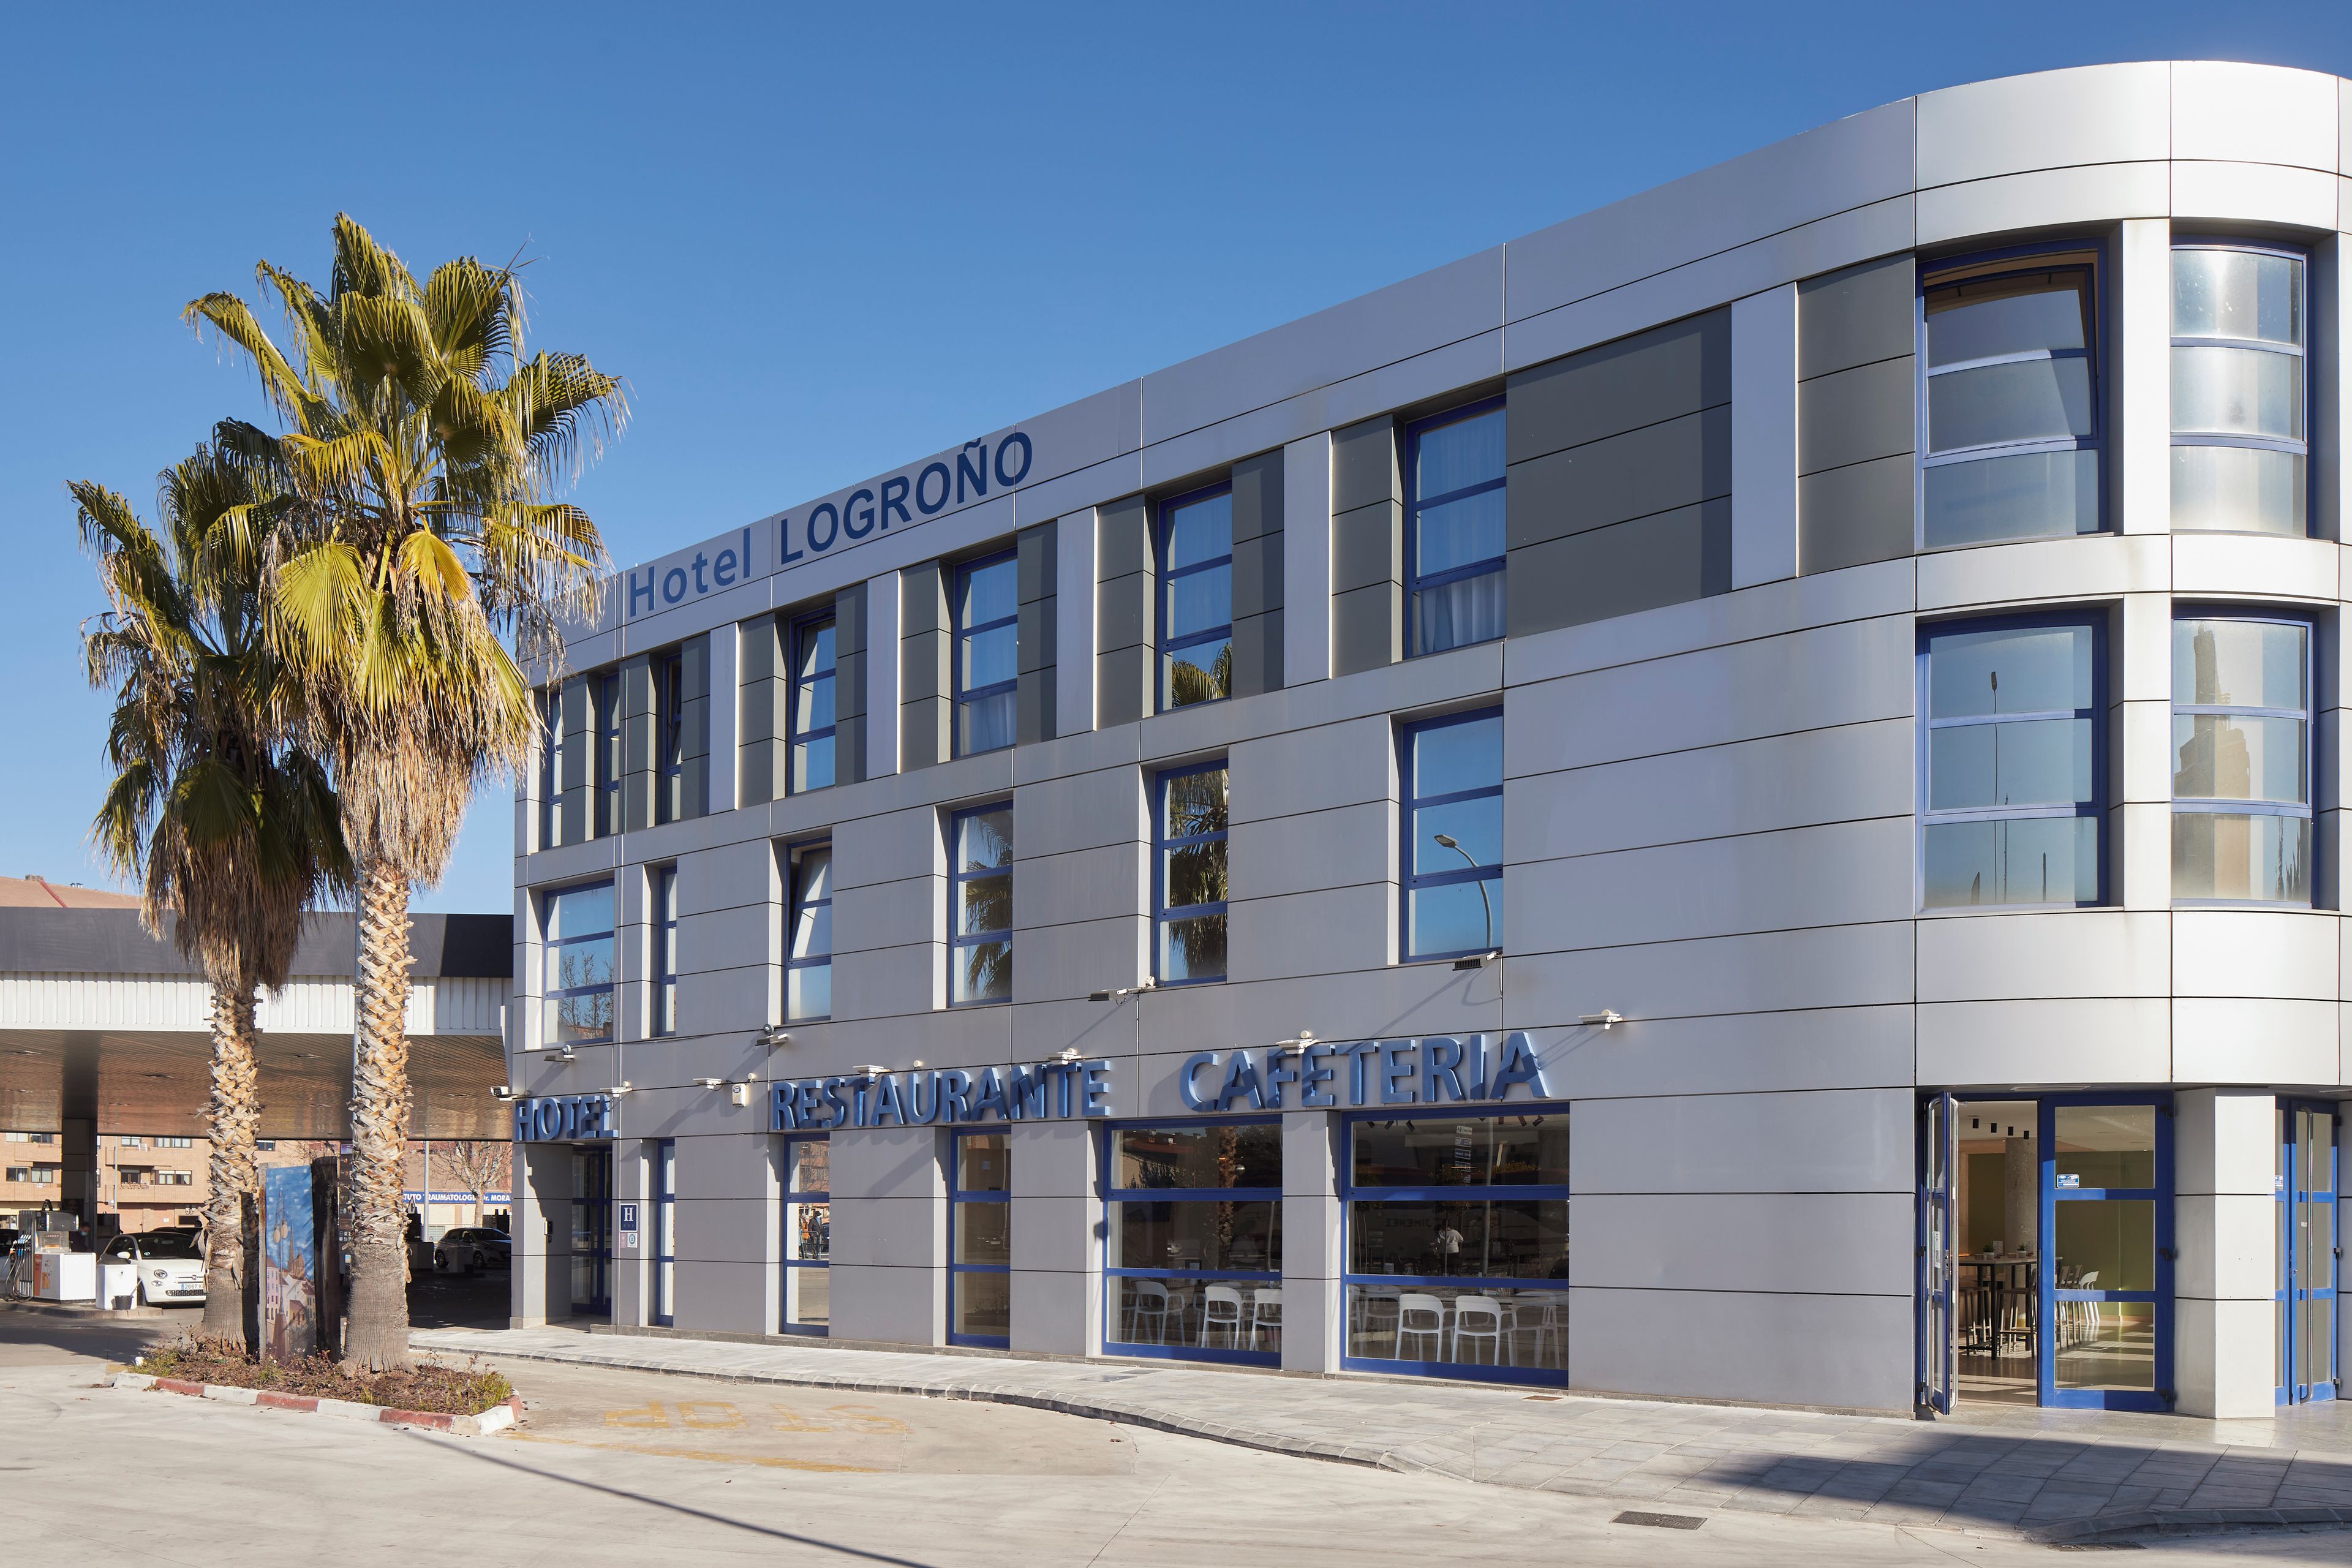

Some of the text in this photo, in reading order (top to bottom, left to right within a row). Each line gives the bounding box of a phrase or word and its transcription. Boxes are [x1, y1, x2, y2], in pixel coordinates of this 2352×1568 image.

[628, 431, 1033, 617] Hotel LOGROÑO
[772, 1032, 1550, 1130] RESTAURANTE CAFETERIA
[516, 1095, 619, 1142] HOTEL
[624, 1207, 633, 1221] H
[605, 1399, 914, 1434] STOP
